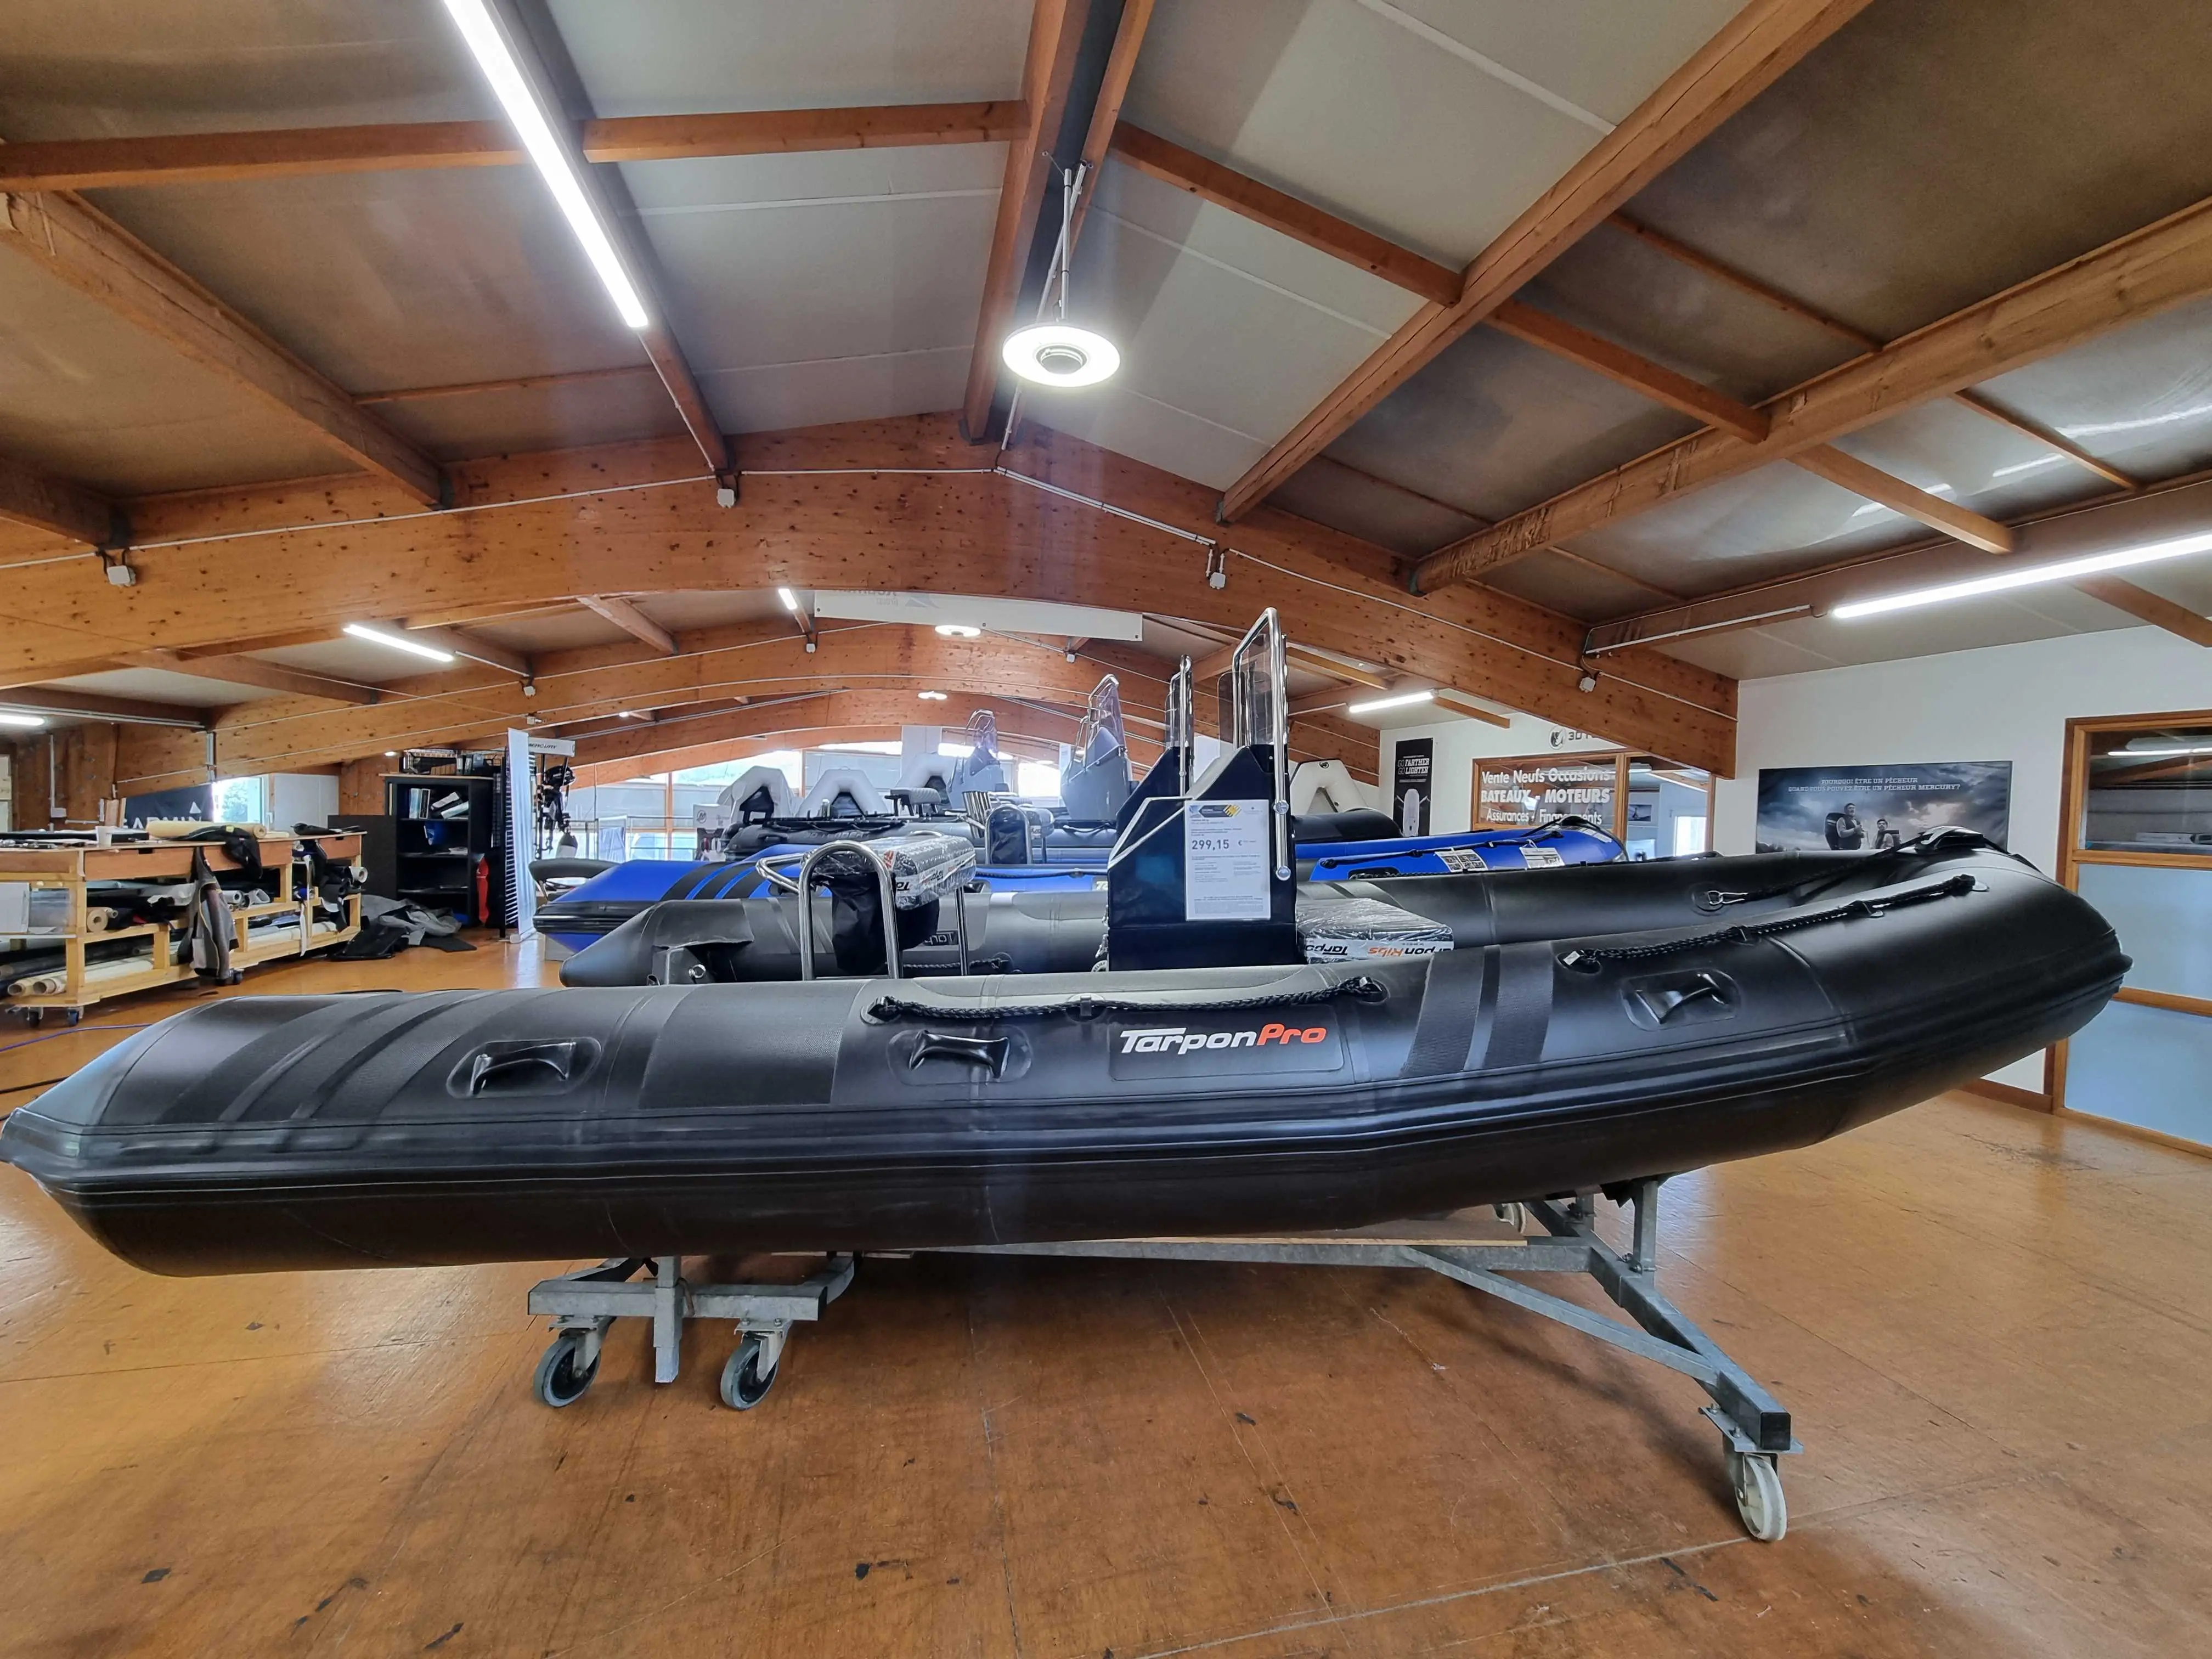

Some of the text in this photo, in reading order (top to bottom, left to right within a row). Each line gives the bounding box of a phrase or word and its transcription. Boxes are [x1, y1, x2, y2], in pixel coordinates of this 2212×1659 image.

[1405, 758, 1430, 766] FARTHER
[1482, 766, 1611, 783] Vente Neufs Occasions
[1481, 789, 1532, 803] BATEAUX
[1544, 788, 1611, 803] MOTEURS
[1486, 809, 1530, 822] Assurances
[1192, 839, 1229, 850] 299,15
[1120, 1023, 1327, 1054] TarponPro
